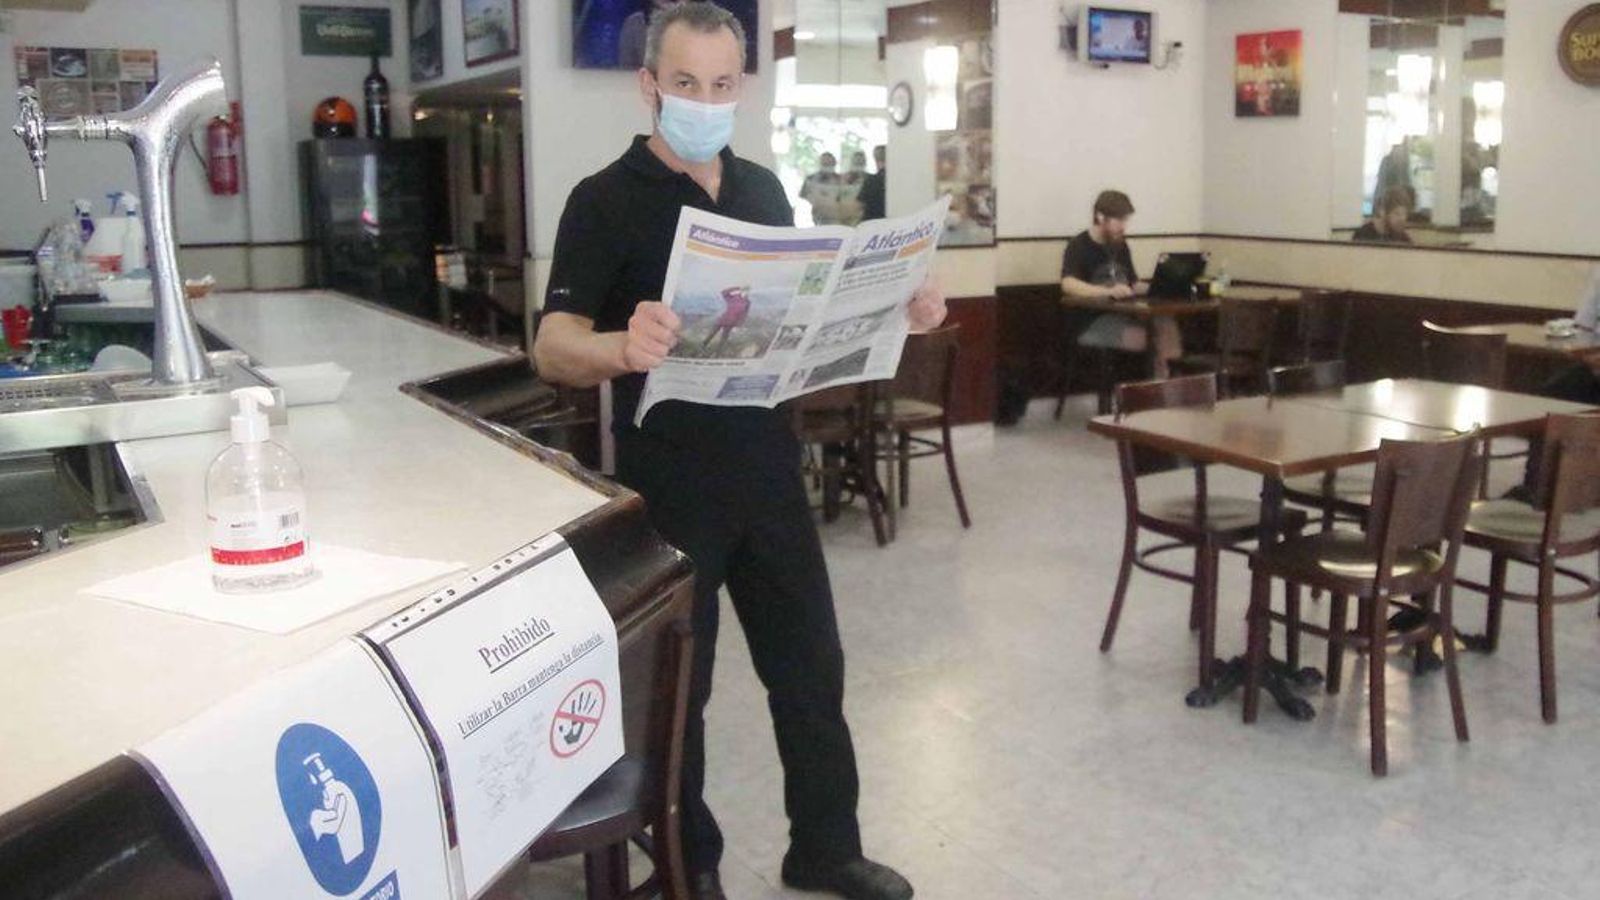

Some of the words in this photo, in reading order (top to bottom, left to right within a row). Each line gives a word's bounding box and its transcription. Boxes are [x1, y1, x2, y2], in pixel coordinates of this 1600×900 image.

[478, 616, 552, 669] Prohibido
[457, 706, 493, 735] Utilizar
[492, 700, 504, 712] la
[502, 683, 527, 705] Barra
[527, 660, 564, 689] mantenga
[562, 652, 572, 664] la
